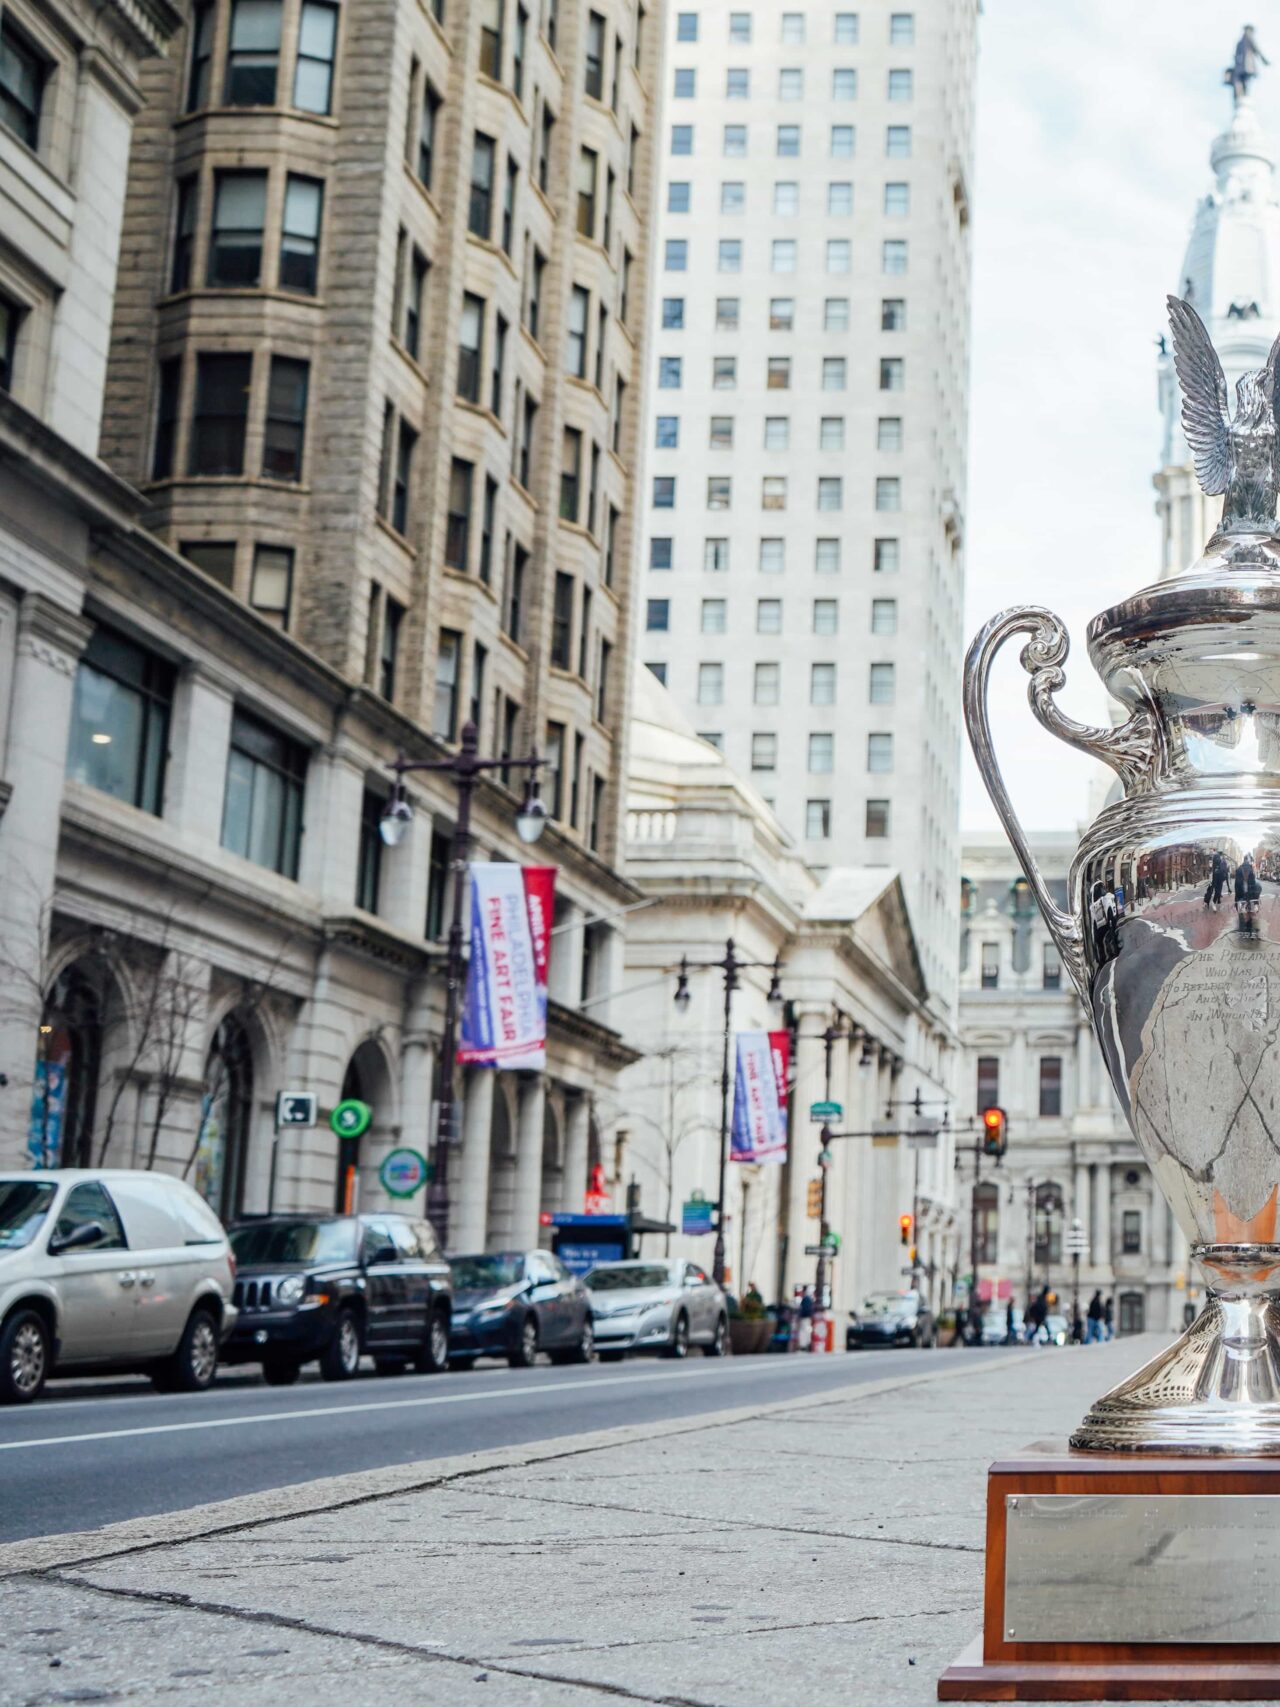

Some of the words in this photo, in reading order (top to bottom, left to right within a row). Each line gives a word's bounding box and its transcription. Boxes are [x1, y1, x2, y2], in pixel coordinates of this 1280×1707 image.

[488, 896, 505, 940] FINE
[529, 894, 545, 936] APRIL
[494, 950, 511, 987] ART
[506, 895, 531, 1036] PHILADELPHIA
[1205, 966, 1227, 977] WHO
[1229, 966, 1253, 977] HAS
[1182, 982, 1232, 992] REFLECT
[500, 997, 516, 1041] FAIR
